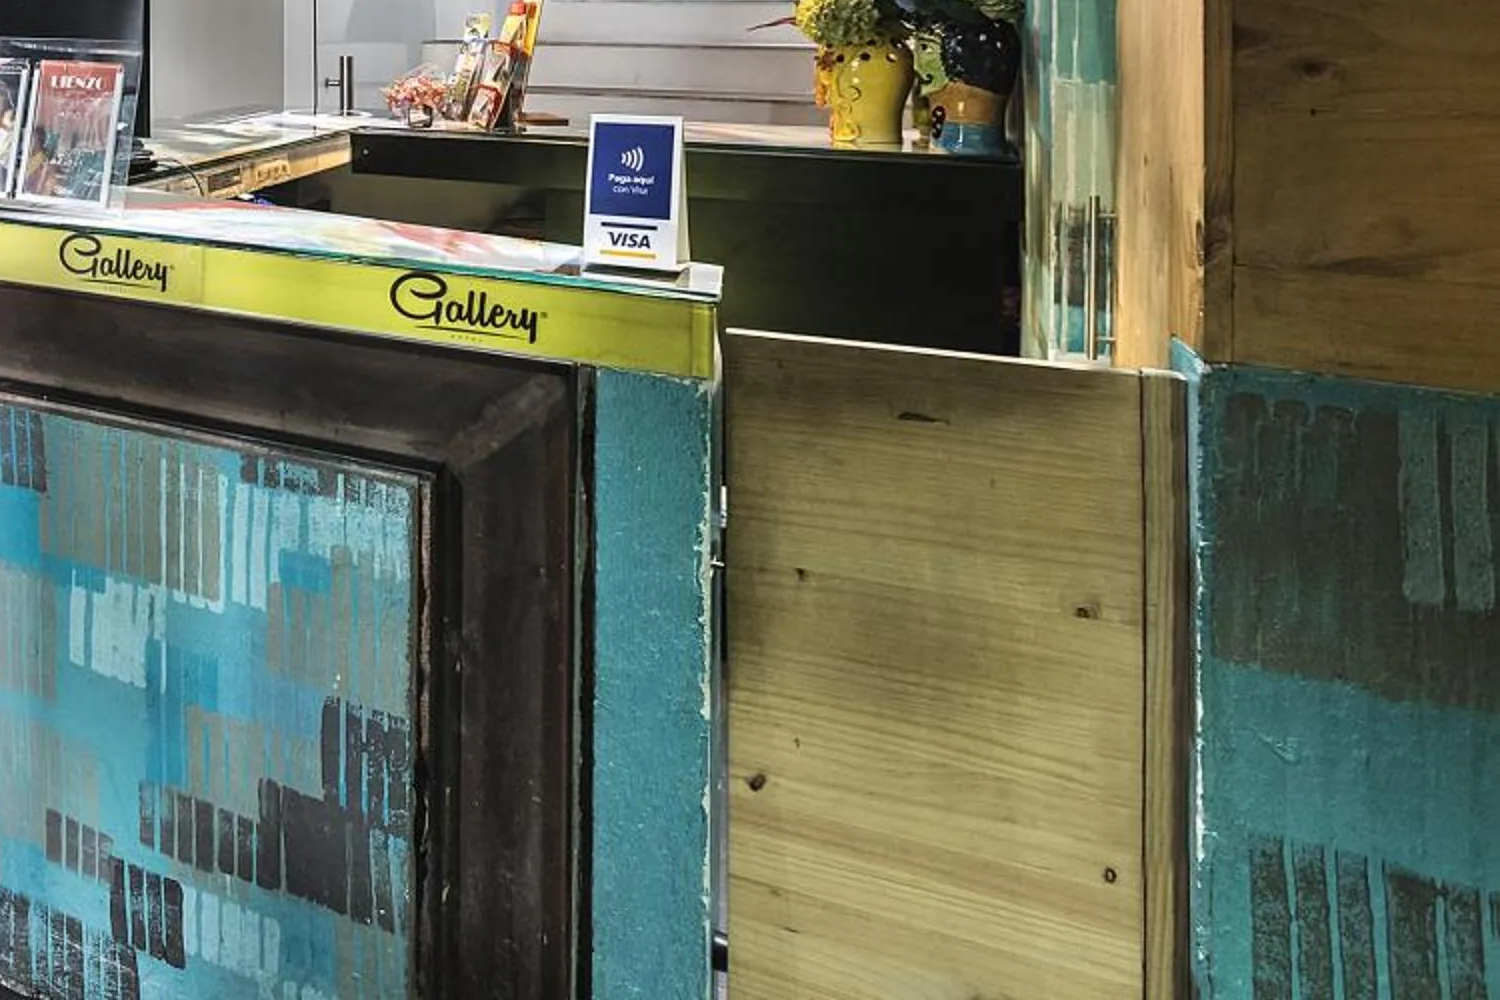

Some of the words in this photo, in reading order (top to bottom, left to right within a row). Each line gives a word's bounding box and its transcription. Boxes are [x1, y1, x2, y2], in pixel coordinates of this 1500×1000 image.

[608, 173, 632, 185] Paga
[609, 231, 651, 249] VISA
[60, 233, 167, 292] Gallery
[390, 271, 537, 344] Gallery
